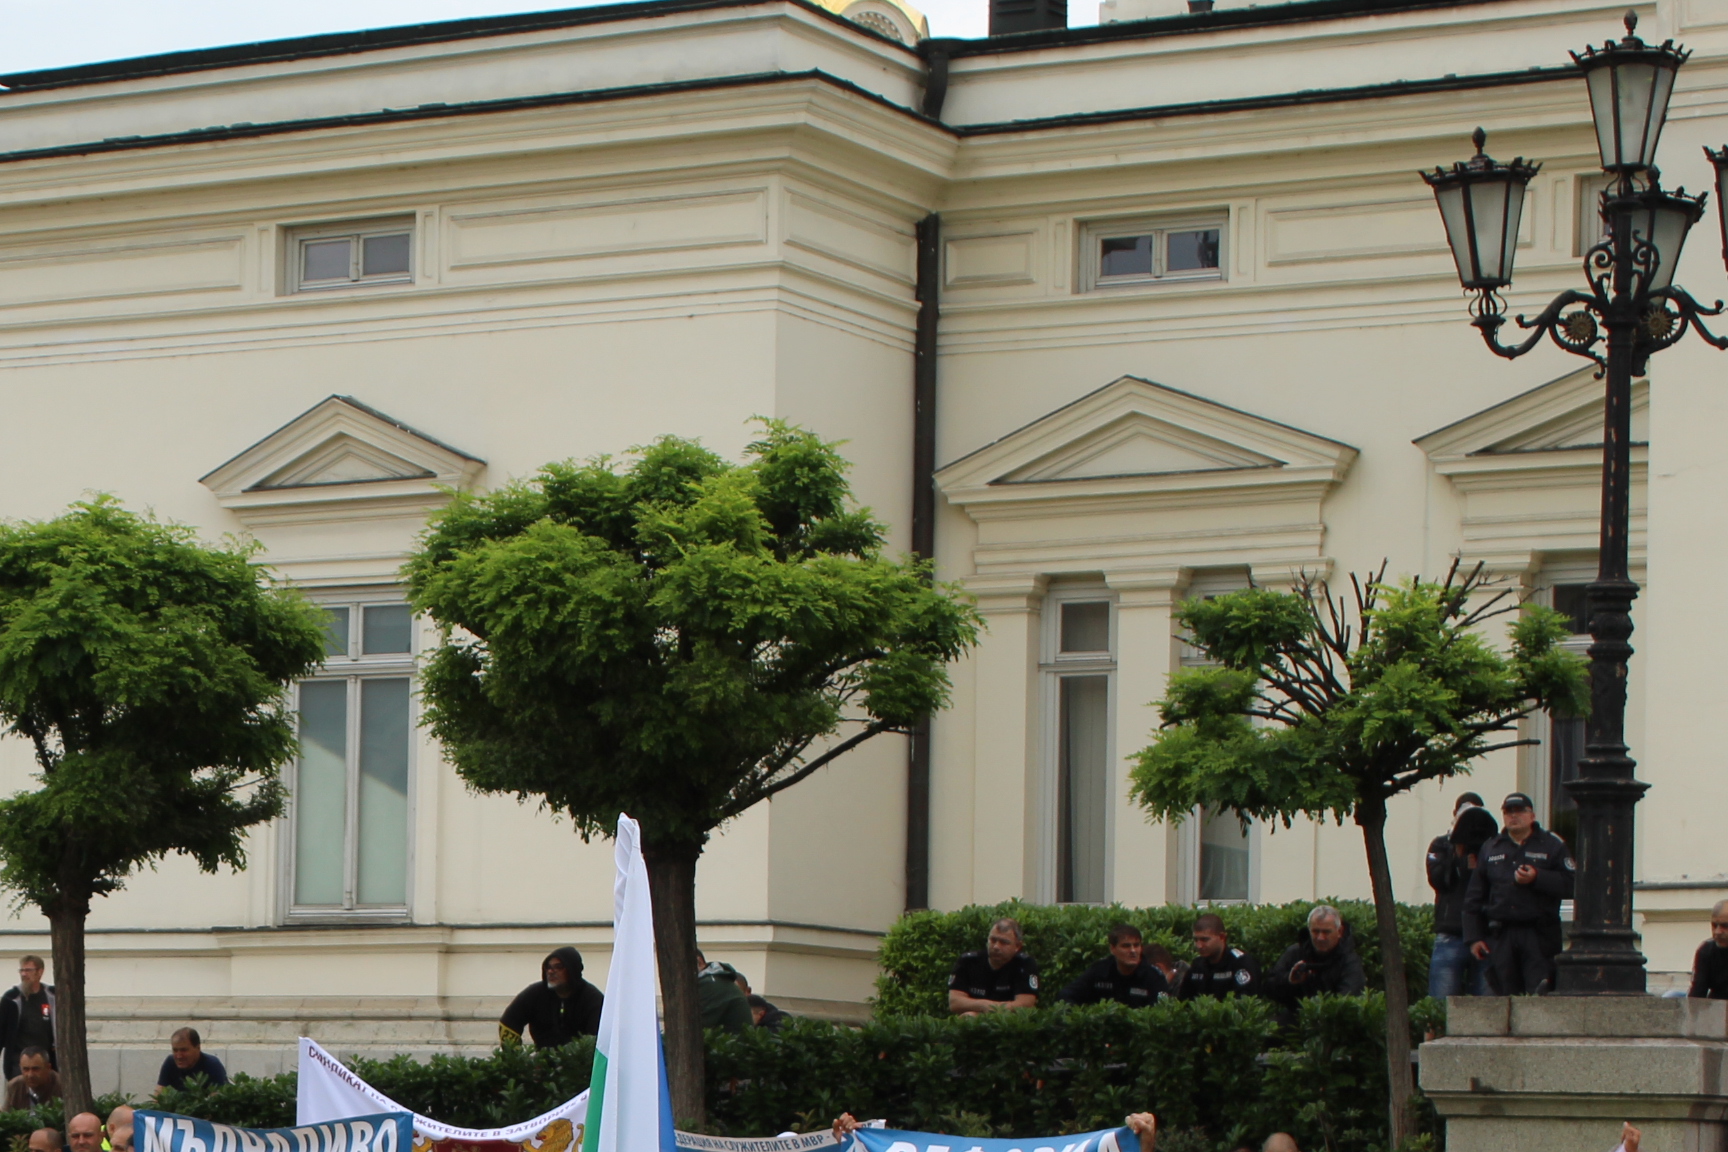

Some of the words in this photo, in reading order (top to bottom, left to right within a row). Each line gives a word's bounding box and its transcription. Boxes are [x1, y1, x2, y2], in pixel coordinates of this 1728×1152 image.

[309, 1046, 366, 1093] СИНДИКАТ
[724, 1138, 792, 1152] СЛУЖИТЕЛИТЕ
[793, 1138, 801, 1149] В
[802, 1134, 824, 1147] МВР
